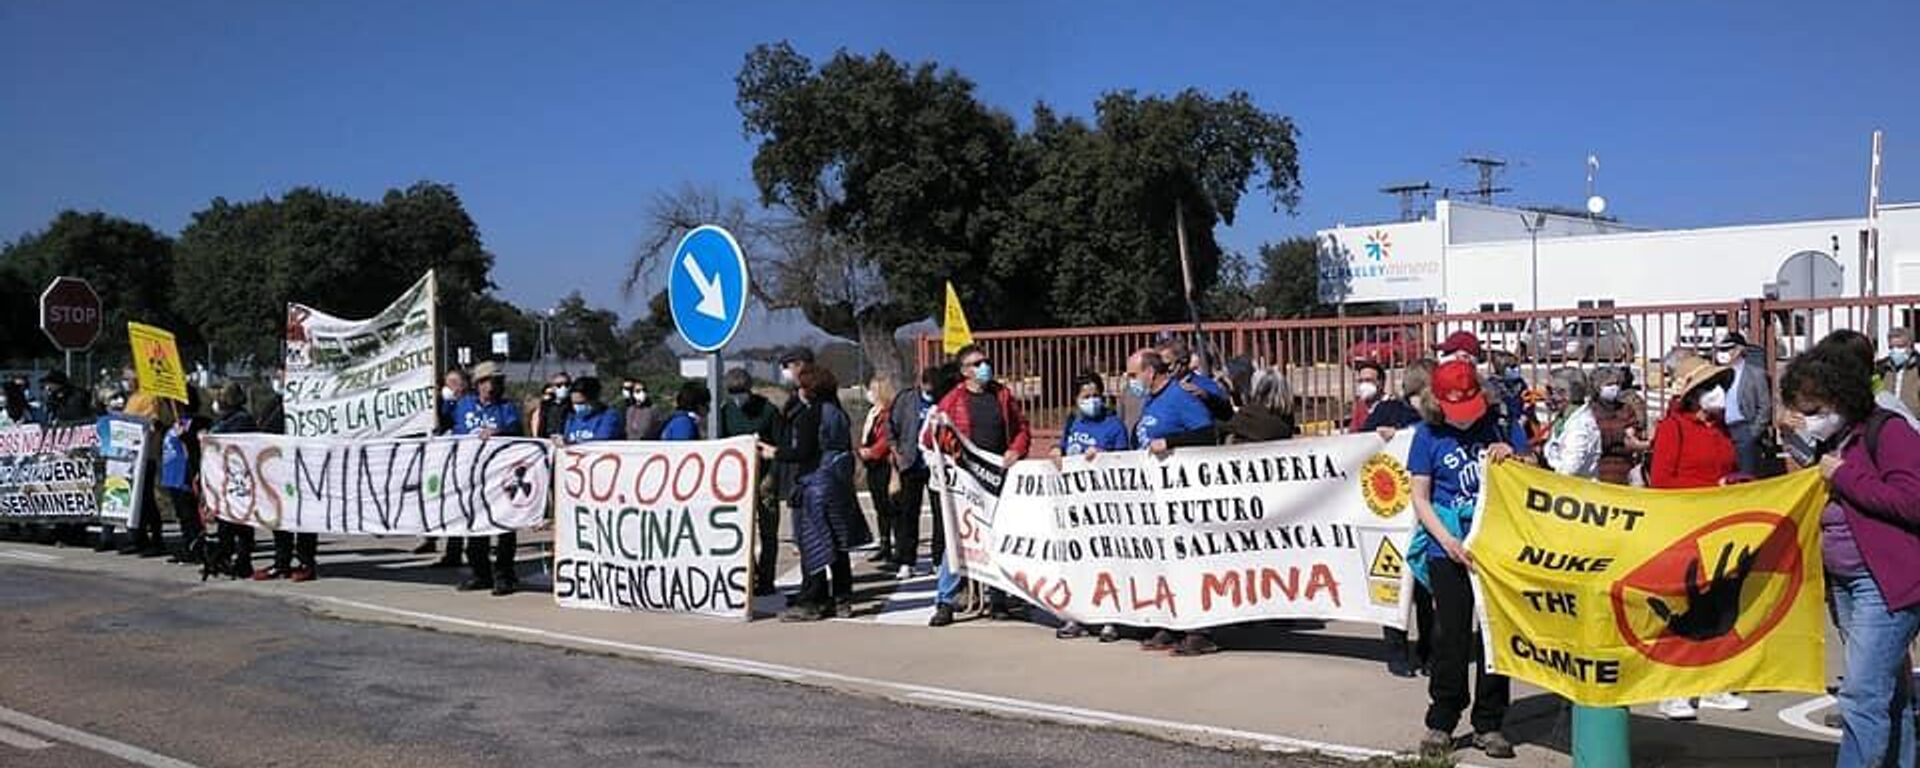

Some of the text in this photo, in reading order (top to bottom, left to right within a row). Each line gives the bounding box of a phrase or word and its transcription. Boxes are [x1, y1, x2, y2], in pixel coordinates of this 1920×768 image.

[50, 306, 97, 323] STOP
[285, 386, 434, 437] DESDE LA FUENTE
[294, 441, 433, 533] MINA
[564, 447, 749, 505] 30.000
[1160, 463, 1192, 490] LA
[1198, 453, 1347, 488] GANADERÍA,
[1139, 501, 1161, 526] EL
[1167, 494, 1264, 525] FUTURO
[1525, 486, 1645, 532] DON'T
[575, 505, 744, 561] ENCINAS
[1000, 534, 1036, 560] DEL
[1089, 536, 1153, 560] CHARRO
[1173, 524, 1325, 561] SALAMANCA
[1517, 544, 1616, 573] NUKE
[556, 559, 748, 611] SENTENCIADAS
[1014, 571, 1071, 612] NO
[1091, 571, 1121, 613] A
[1129, 575, 1178, 619] LA
[1200, 563, 1342, 612] MINA
[1522, 589, 1577, 619] THE
